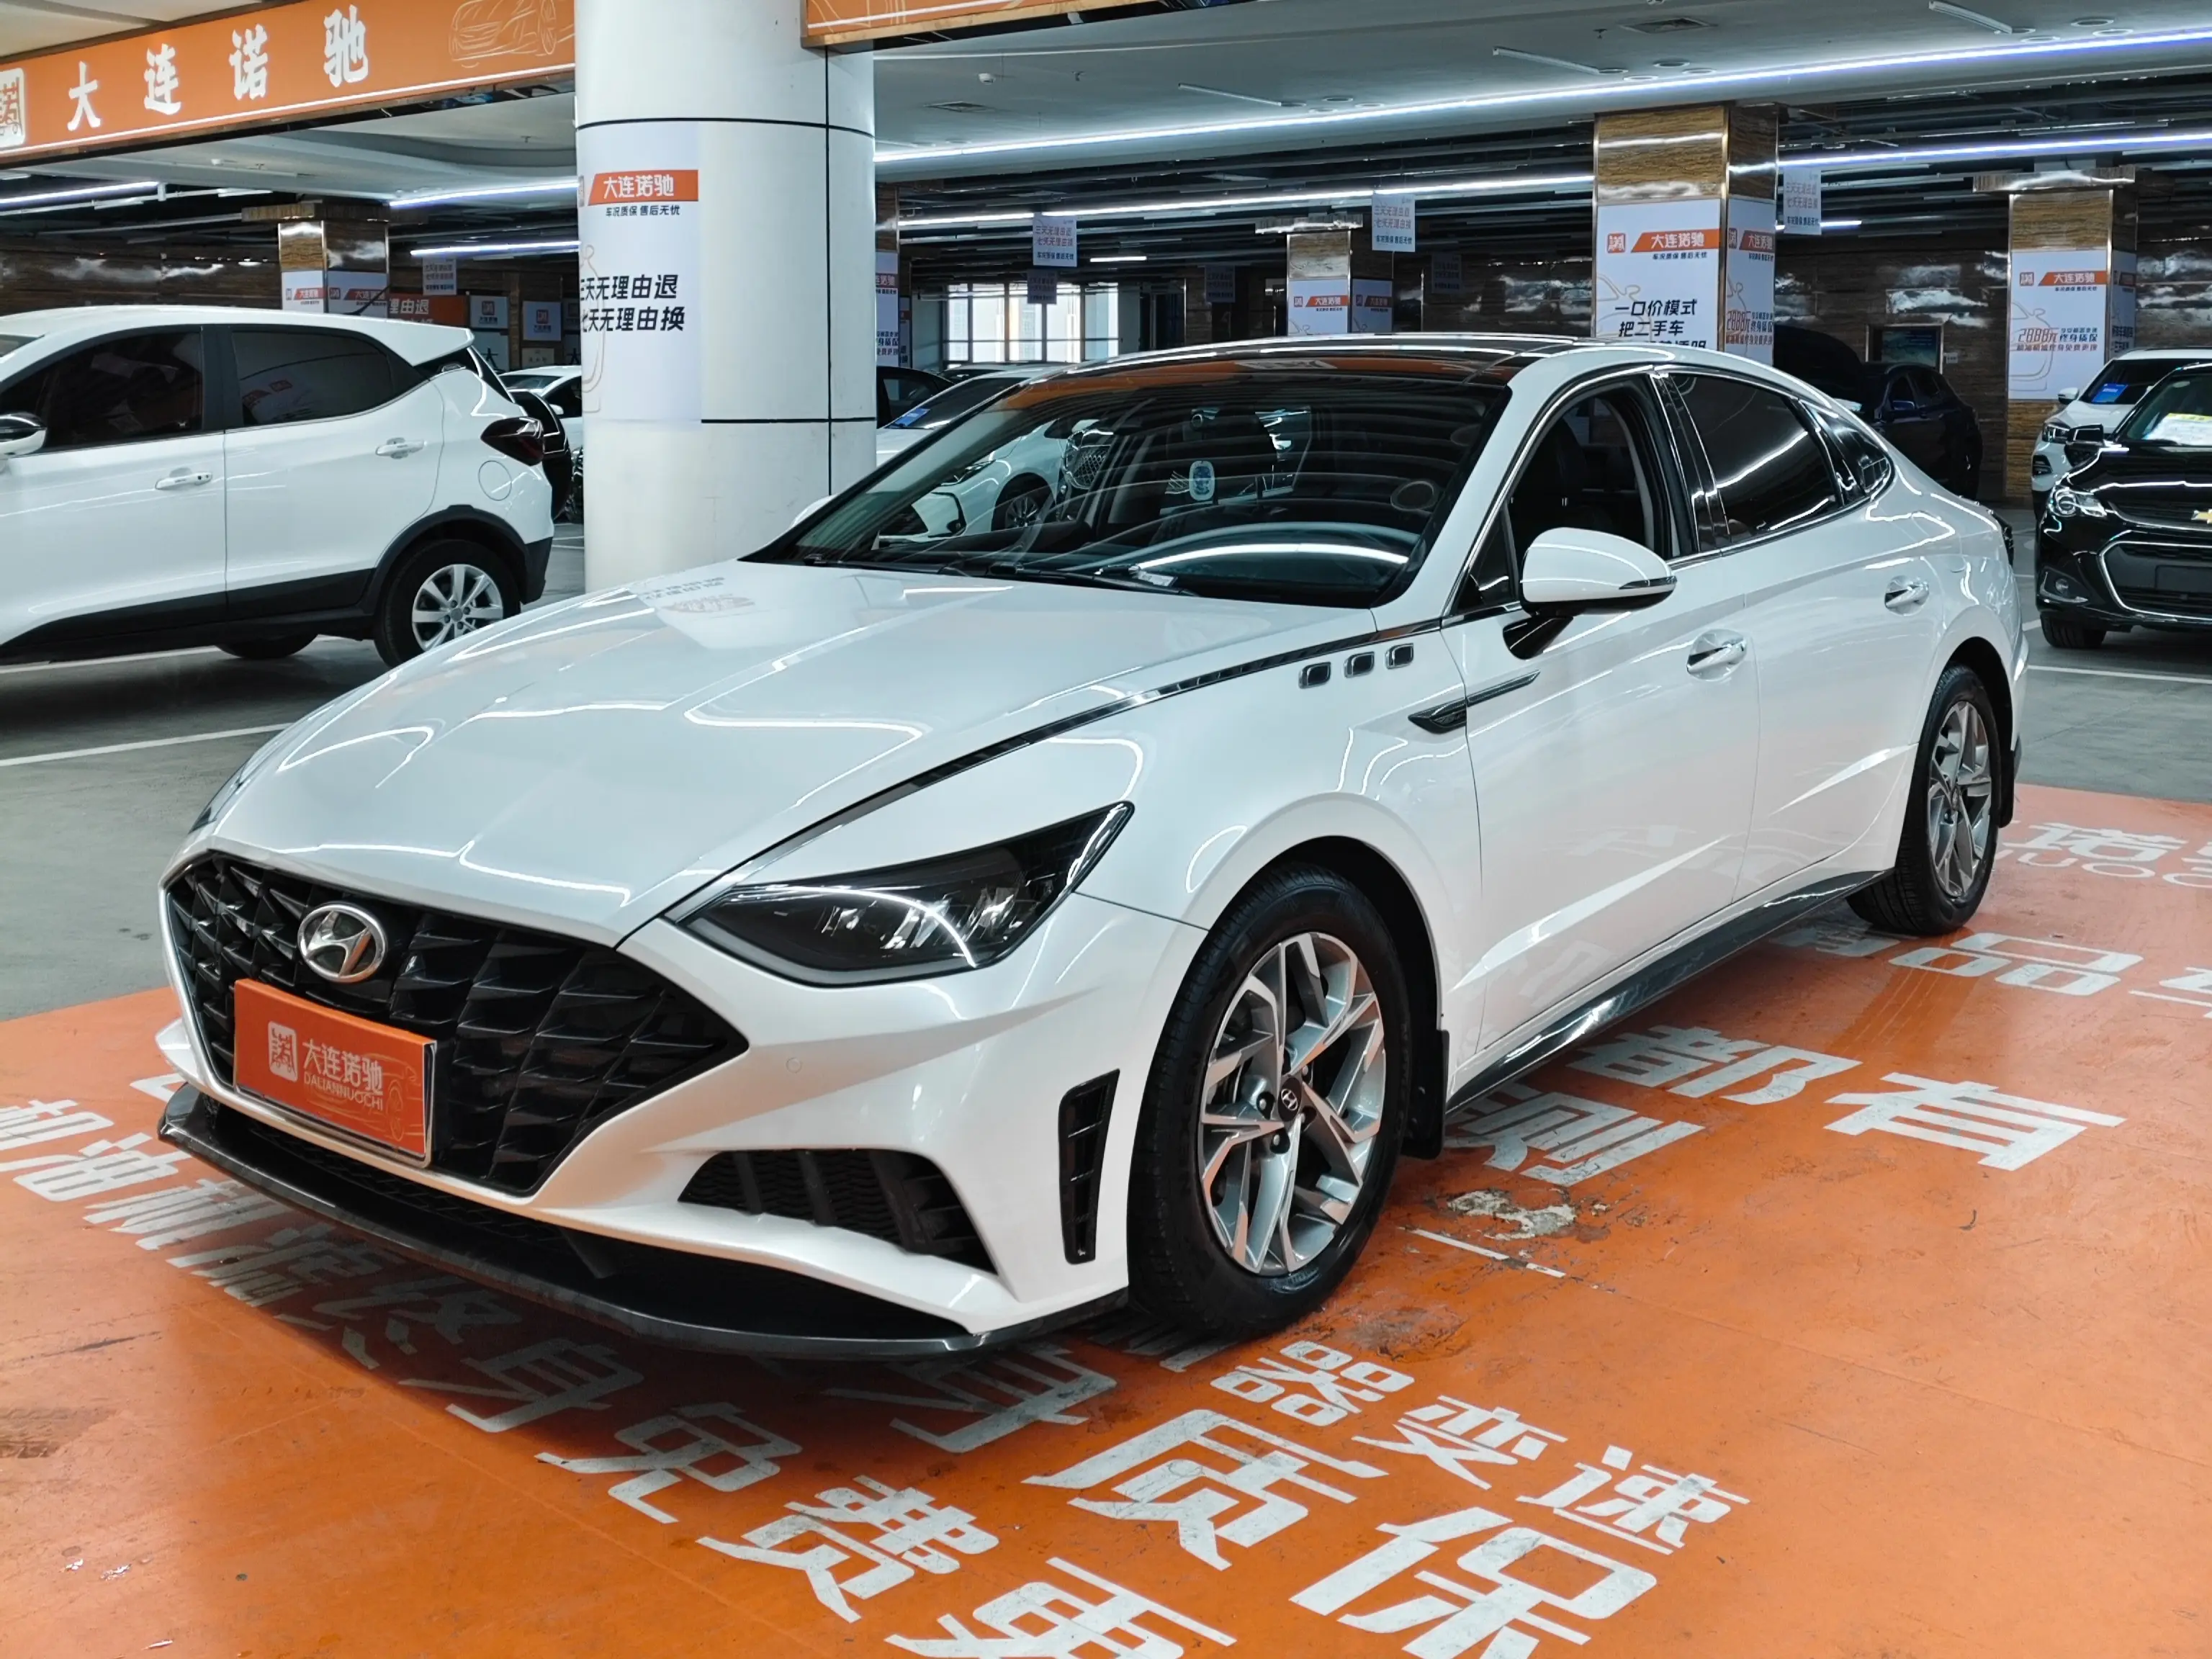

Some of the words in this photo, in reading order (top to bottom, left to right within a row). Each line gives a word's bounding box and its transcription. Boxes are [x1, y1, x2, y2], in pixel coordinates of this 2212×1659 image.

[67, 4, 369, 131] 大连诺驰
[603, 174, 674, 199] 大连诺驰
[606, 206, 638, 217] 车况质保
[639, 204, 680, 216] 售后无忧
[1651, 232, 1704, 249] 大连诺驰
[2054, 273, 2095, 284] 大连诺驰
[1615, 299, 1697, 317] 一口价模式
[1619, 320, 1686, 338] 把二手车
[302, 1038, 384, 1096] 大连诺驰
[303, 1071, 383, 1111] DALIANNUOCHI
[1567, 1025, 2126, 1172] 都有
